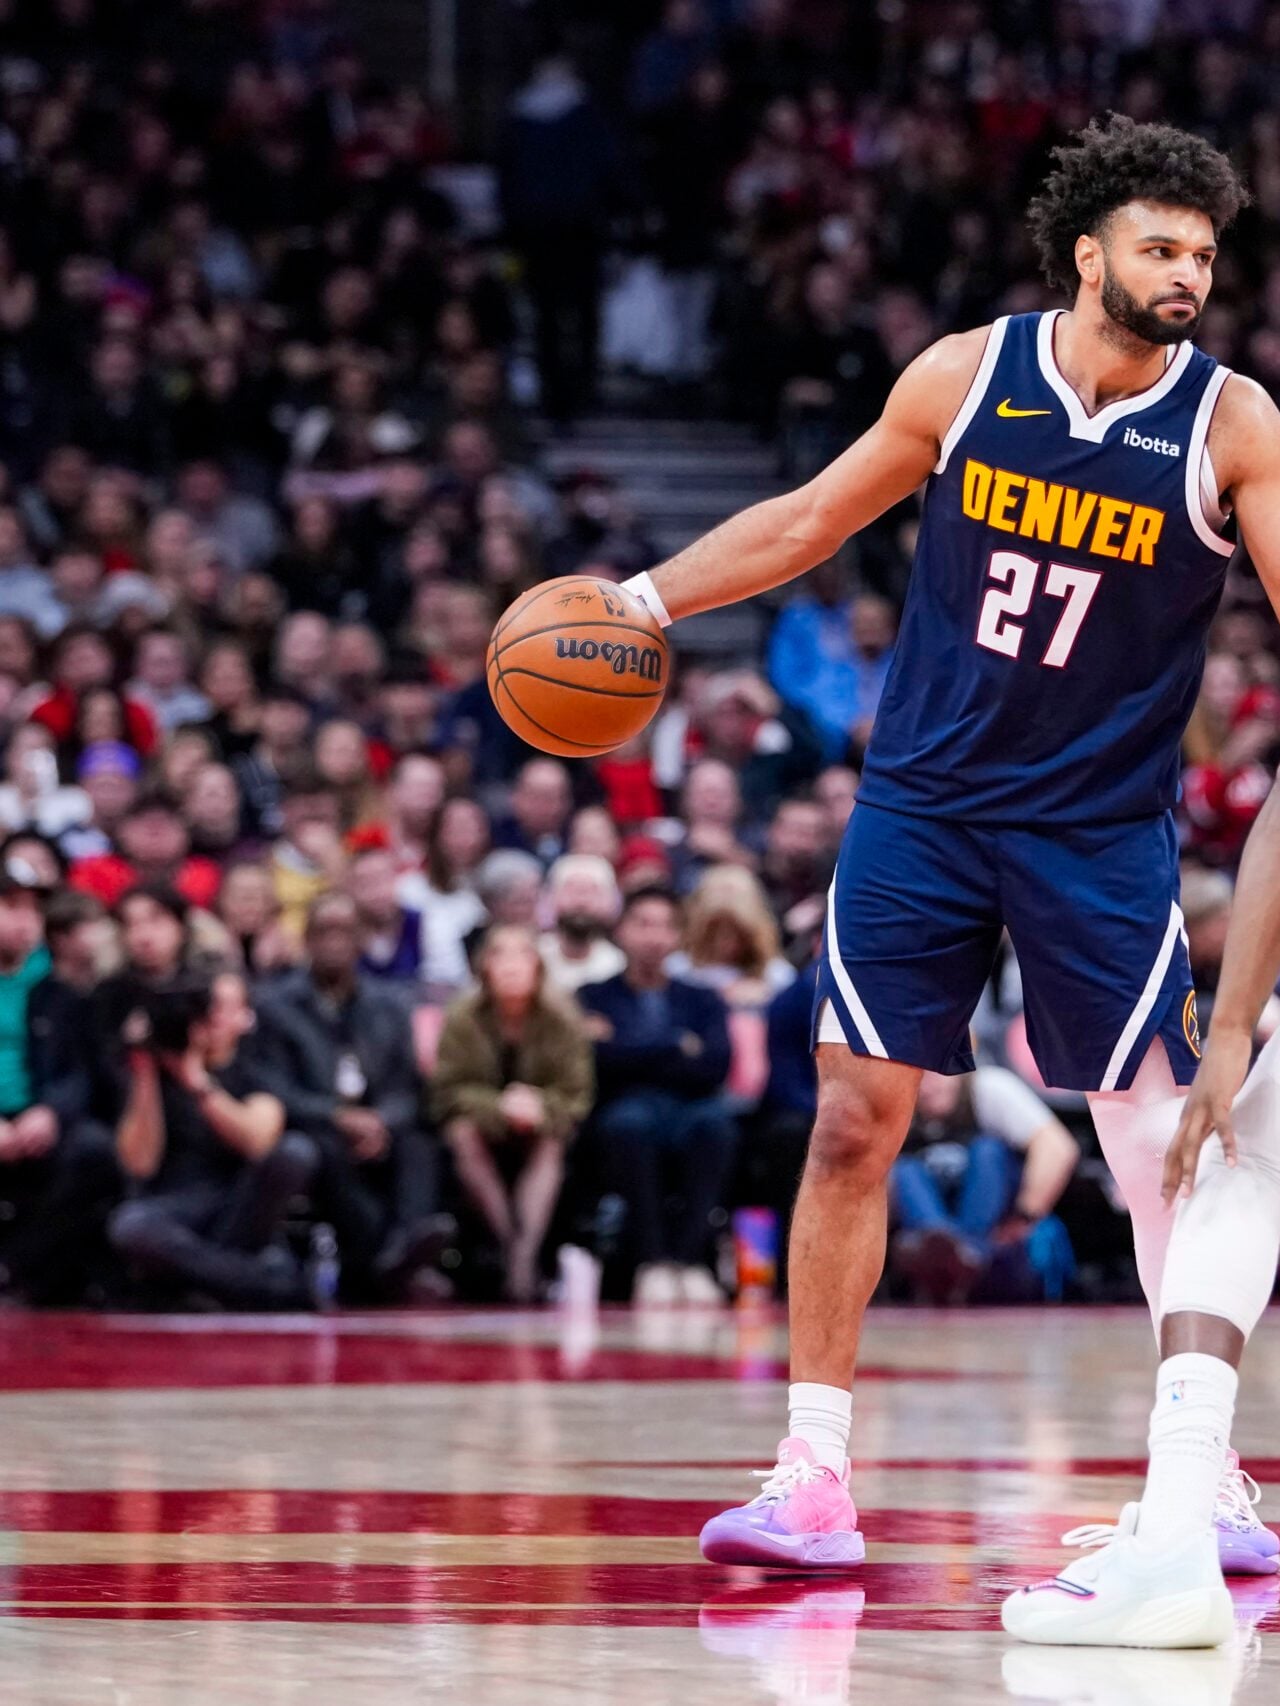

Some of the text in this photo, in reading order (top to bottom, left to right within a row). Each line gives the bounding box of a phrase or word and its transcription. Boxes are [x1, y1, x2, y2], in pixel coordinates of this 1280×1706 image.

[1123, 427, 1180, 457] ibotta
[962, 457, 1166, 567] DENVER
[975, 548, 1105, 670] 27
[554, 636, 662, 684] Wilson
